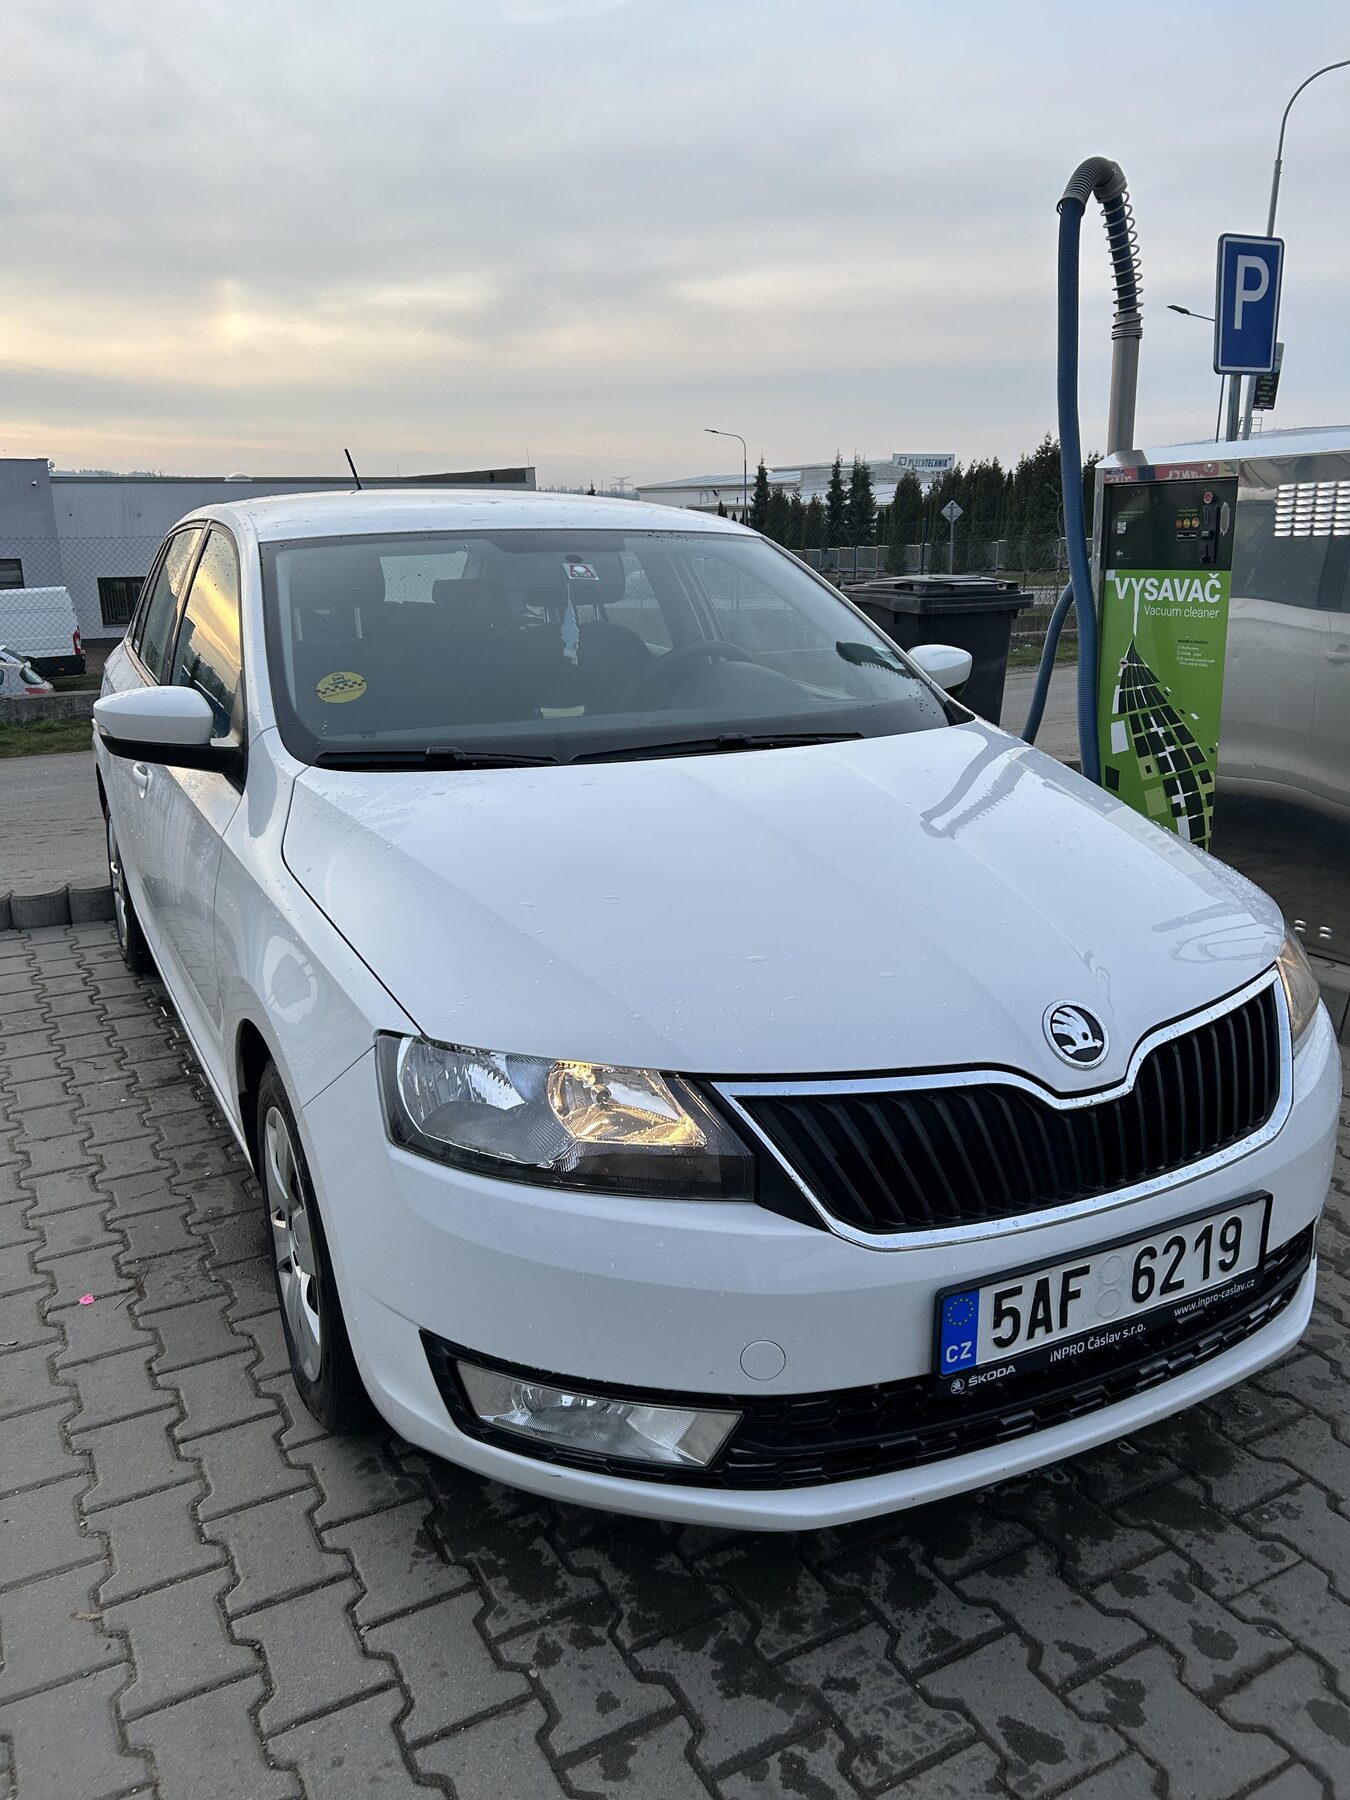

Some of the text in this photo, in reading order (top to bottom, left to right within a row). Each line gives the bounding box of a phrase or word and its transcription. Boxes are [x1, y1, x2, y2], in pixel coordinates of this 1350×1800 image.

[1233, 254, 1270, 330] P
[907, 458, 948, 468] PLECHTECHNIK
[1114, 573, 1221, 604] VYSAVAČ
[1144, 604, 1220, 619] Vacuum cleaner
[991, 1215, 1243, 1348] 5AF 6219
[1173, 1279, 1256, 1317] www.inpro-caslav.cz
[1087, 1331, 1121, 1350] Čáslav
[1122, 1323, 1146, 1338] s.r.o.
[945, 1340, 972, 1363] CZ
[968, 1365, 1016, 1387] ŠKODA
